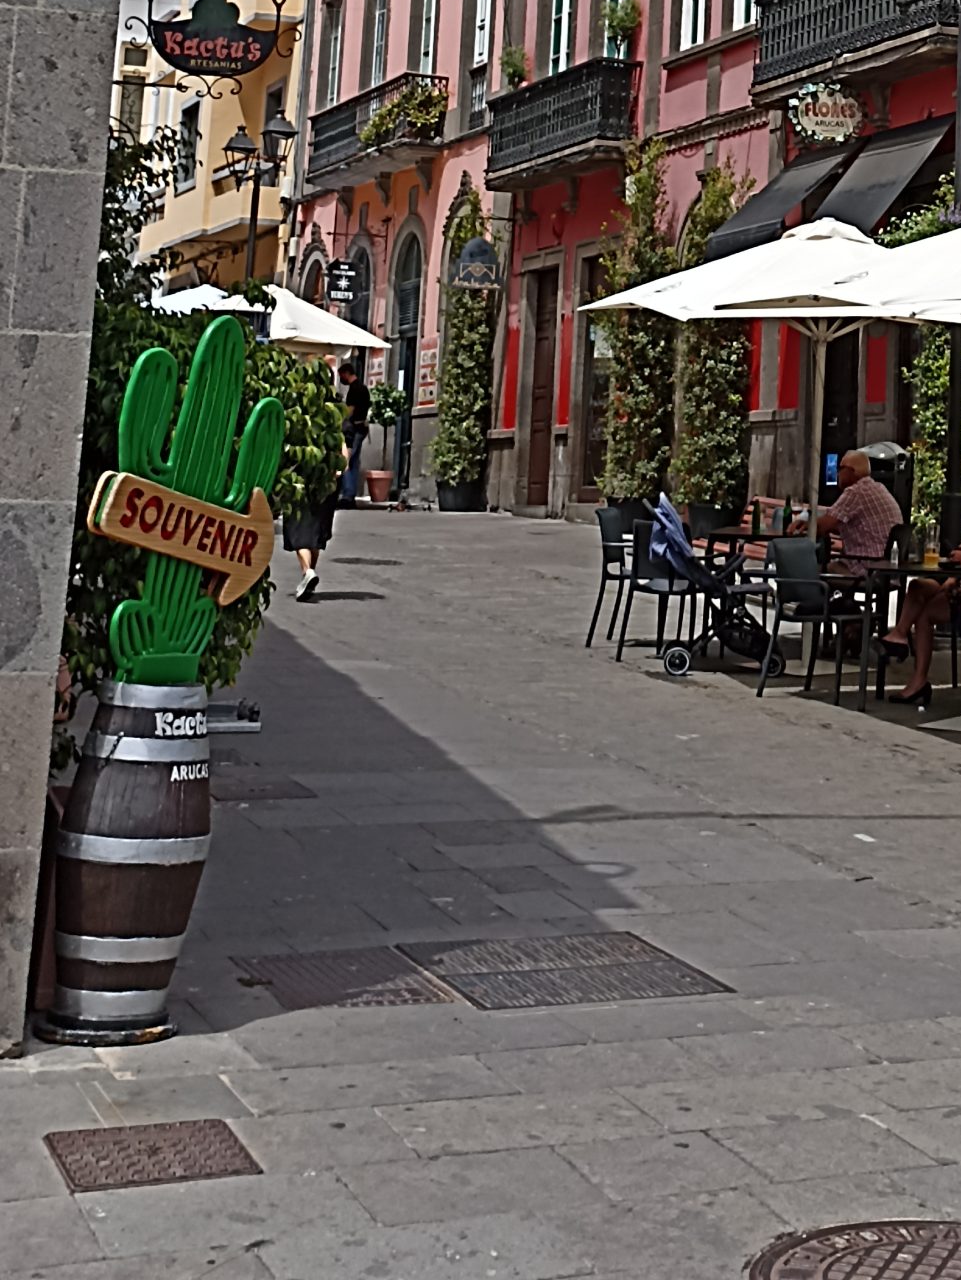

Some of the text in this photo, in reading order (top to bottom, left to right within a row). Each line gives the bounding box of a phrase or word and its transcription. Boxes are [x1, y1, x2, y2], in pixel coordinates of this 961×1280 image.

[164, 31, 262, 62] Kactu's
[190, 59, 242, 69] RTESANIAS
[119, 487, 259, 567] SOUVENIR
[170, 763, 209, 782] ARUCAS
